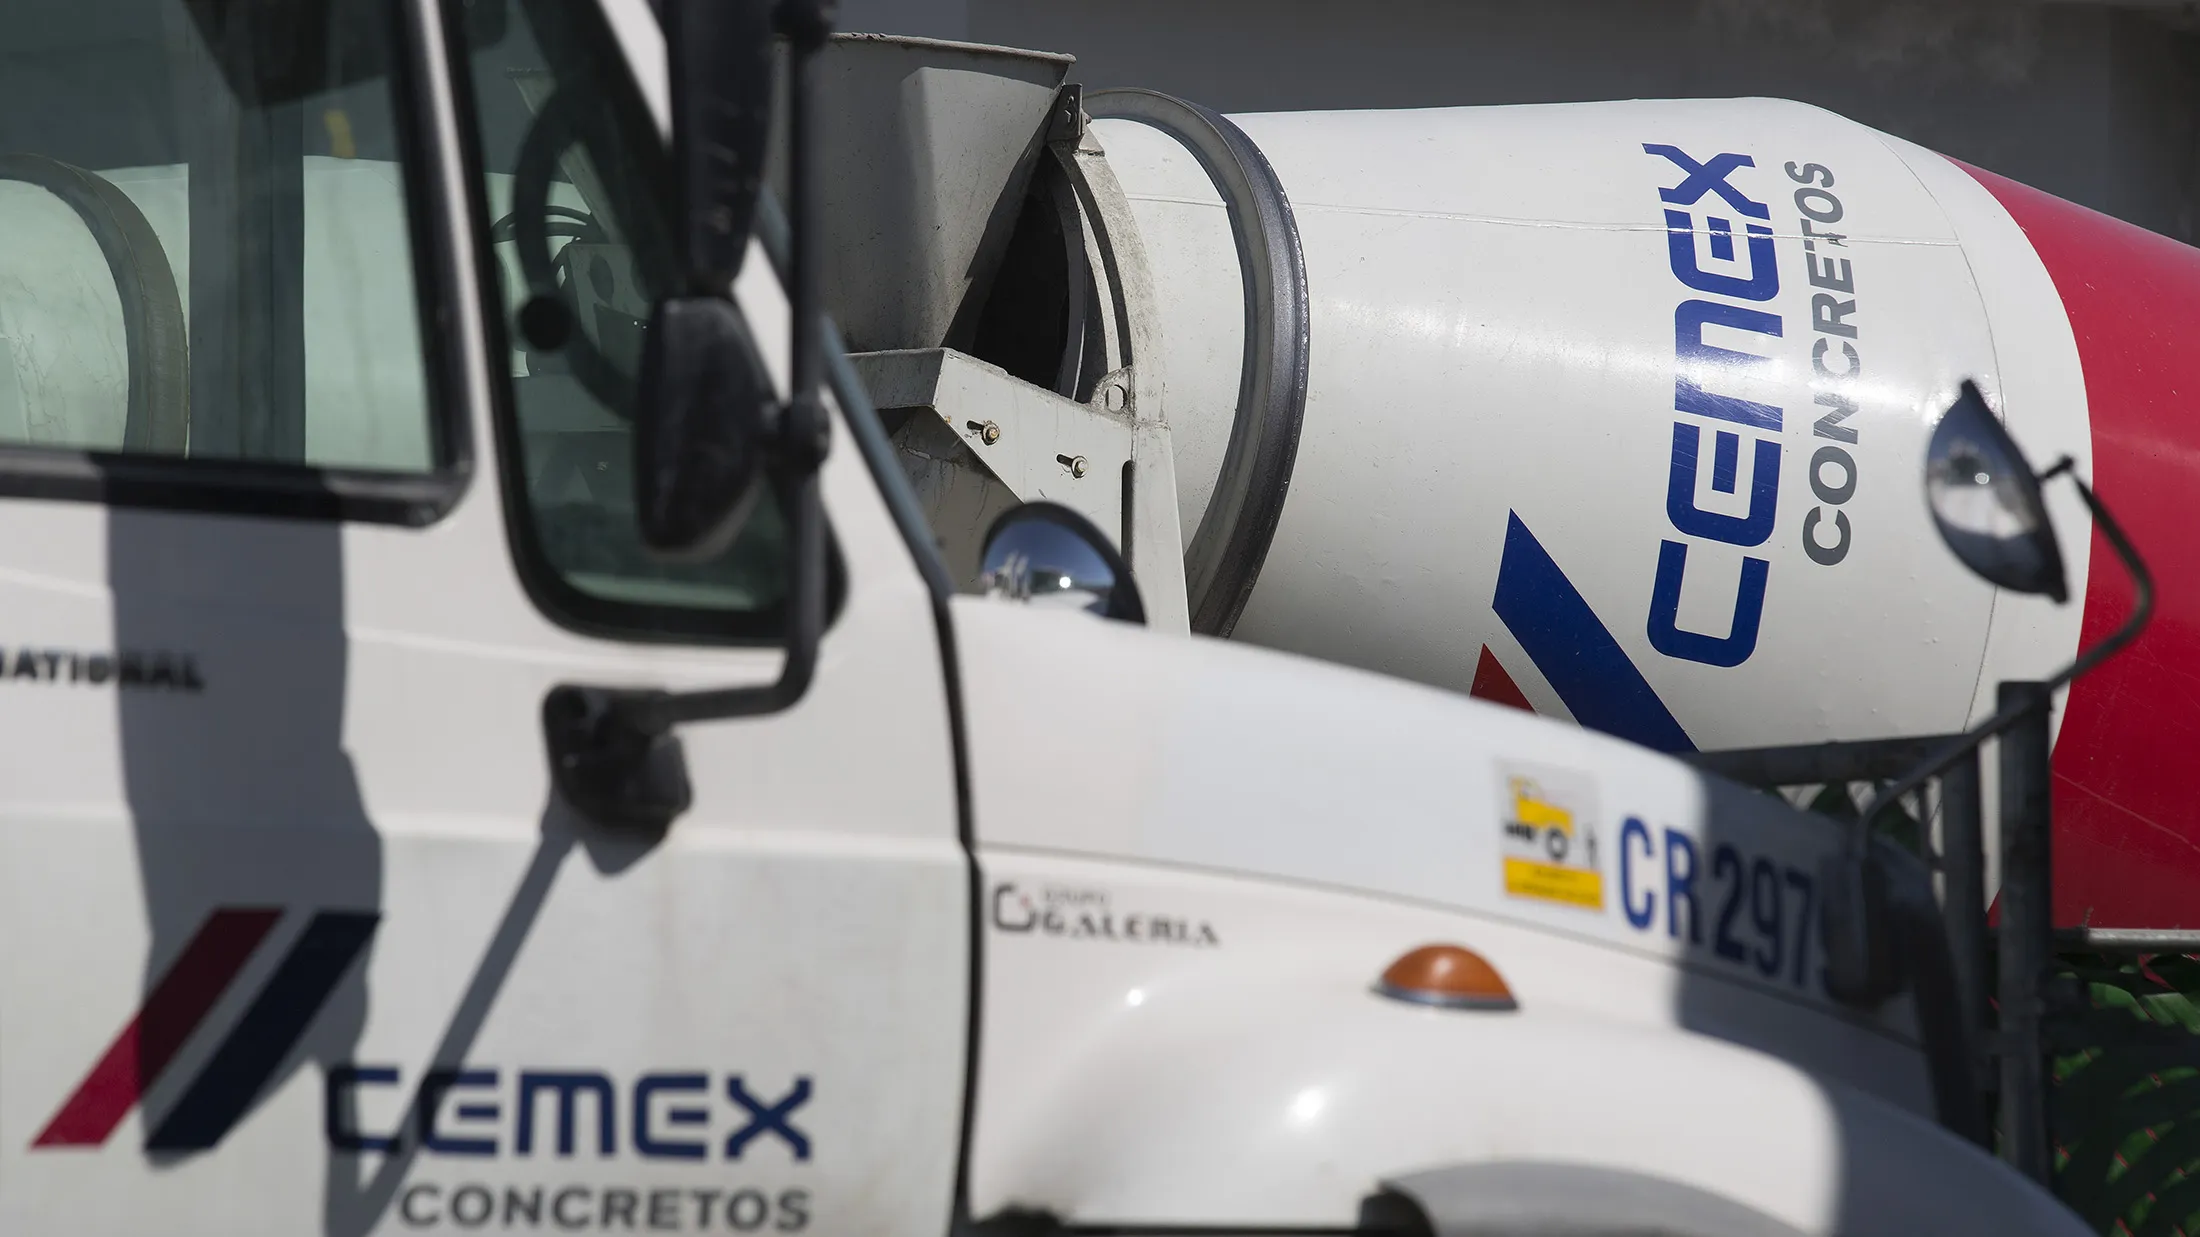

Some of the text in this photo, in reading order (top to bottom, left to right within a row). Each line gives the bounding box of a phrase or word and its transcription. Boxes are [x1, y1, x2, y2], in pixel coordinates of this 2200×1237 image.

[1641, 141, 1785, 669] CEMEX
[1783, 159, 1861, 567] CONCRETOS
[0, 648, 204, 690] ATIONAL
[1043, 909, 1221, 948] GALERIA
[1619, 815, 1842, 998] CR297
[325, 1066, 813, 1161] CEMEX
[402, 1184, 811, 1233] CONCRETOS
